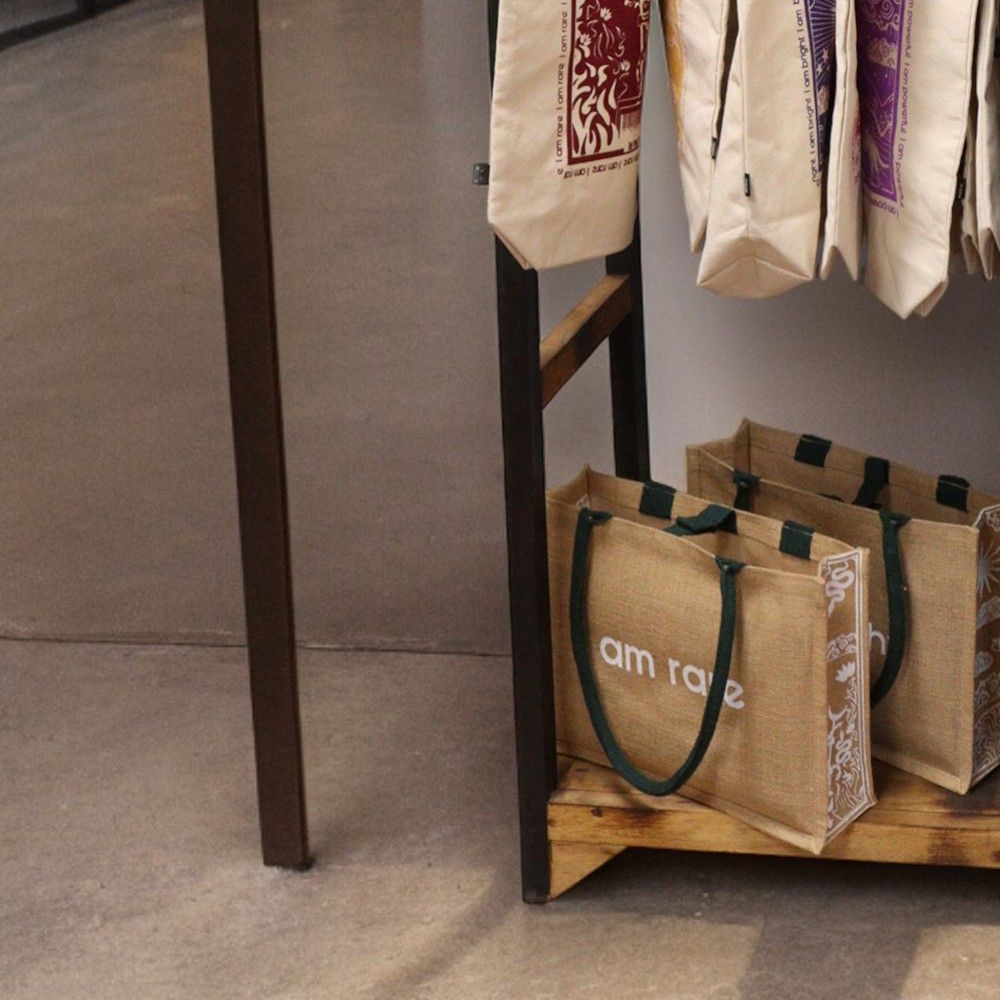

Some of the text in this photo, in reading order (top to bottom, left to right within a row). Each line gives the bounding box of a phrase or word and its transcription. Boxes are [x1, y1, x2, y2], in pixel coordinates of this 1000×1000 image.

[560, 12, 568, 31] rare
[795, 10, 804, 25] am
[560, 33, 567, 51] am
[905, 9, 914, 57] powerful
[798, 36, 809, 69] bright
[803, 71, 810, 87] am
[902, 68, 909, 85] am
[557, 87, 565, 104] am
[804, 97, 815, 130] bright
[901, 87, 909, 134] powerful
[556, 139, 563, 158] am
[809, 132, 816, 149] am
[898, 143, 905, 161] am
[599, 636, 656, 679] am
